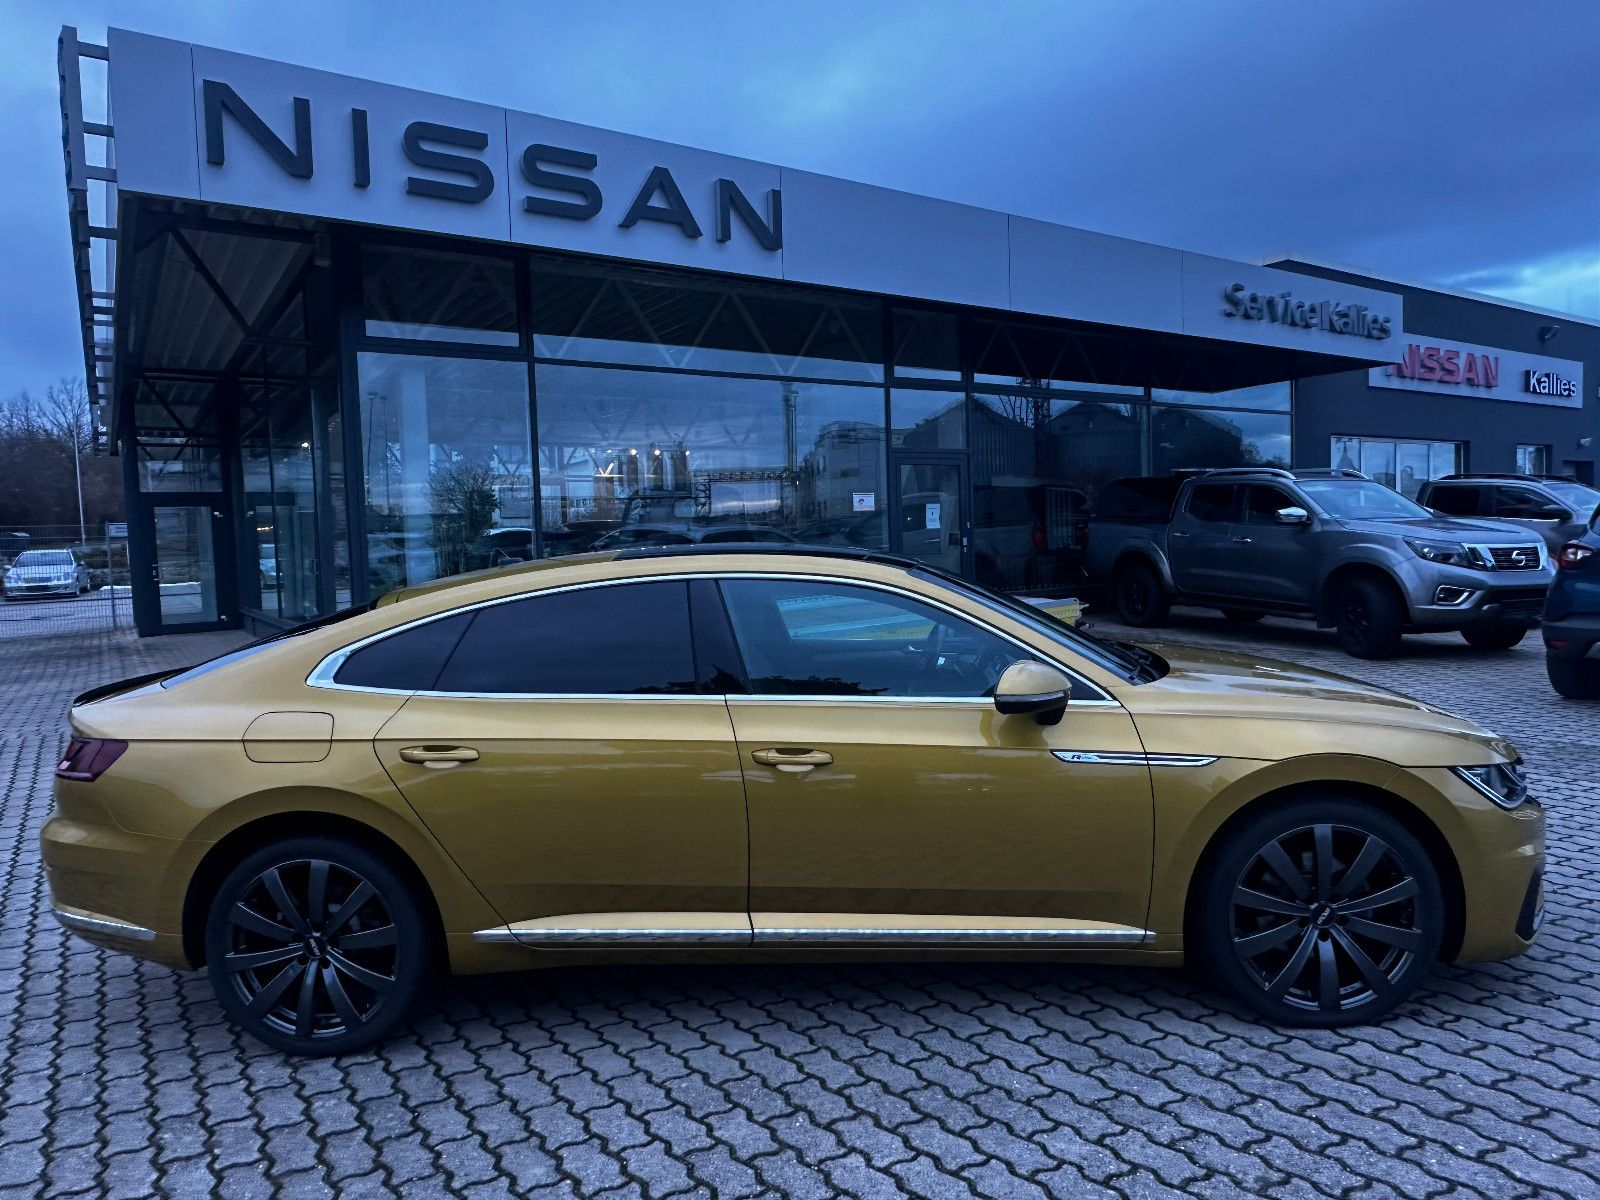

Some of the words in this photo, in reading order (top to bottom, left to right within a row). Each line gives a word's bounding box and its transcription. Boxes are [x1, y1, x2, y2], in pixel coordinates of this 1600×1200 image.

[202, 78, 783, 251] NISSAN
[1223, 282, 1319, 329] Service
[1318, 300, 1392, 340] Kallies
[1525, 368, 1578, 398] Kallies
